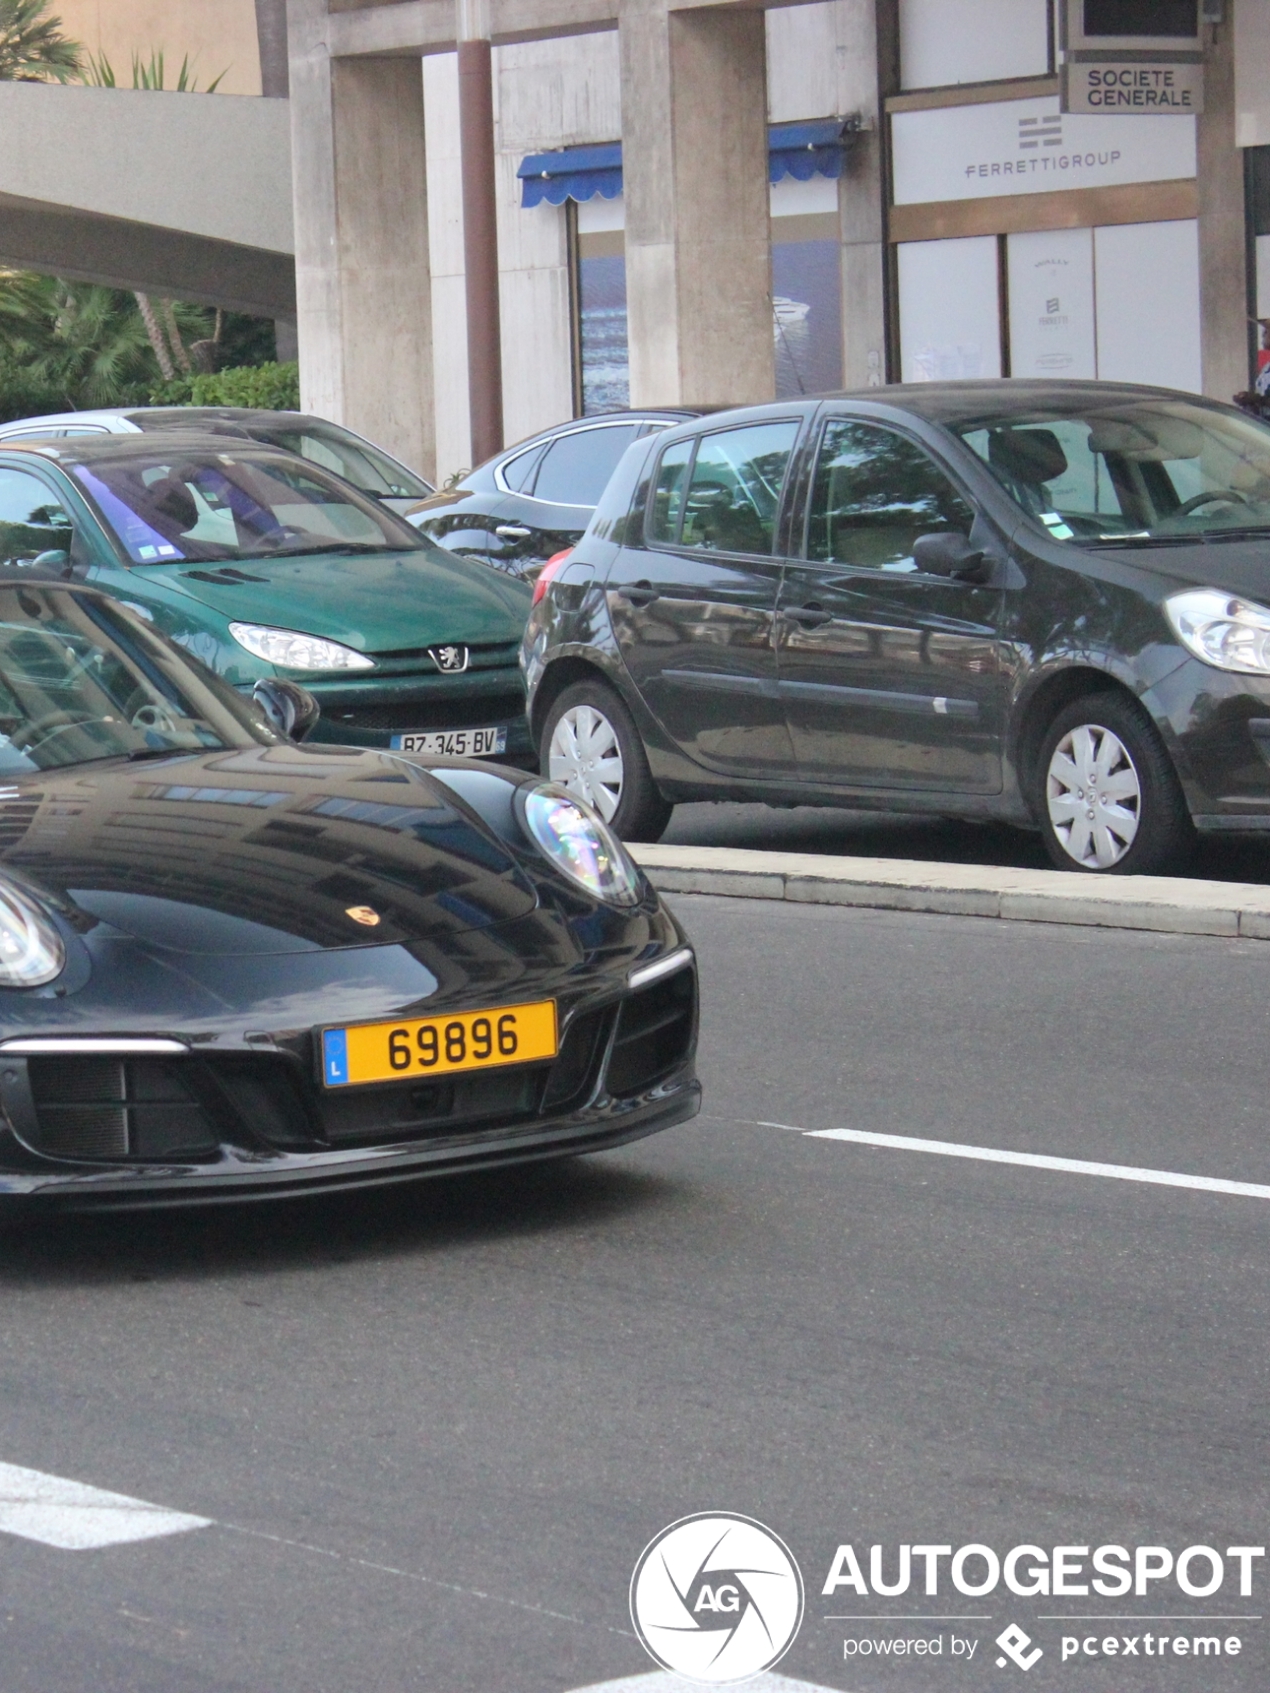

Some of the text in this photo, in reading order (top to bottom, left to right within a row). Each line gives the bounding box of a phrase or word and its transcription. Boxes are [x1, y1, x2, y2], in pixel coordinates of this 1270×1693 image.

[1088, 70, 1174, 86] SOCIETE
[1087, 89, 1192, 106] GENERALE
[964, 150, 1121, 178] FERRETTIGROUP
[330, 1014, 518, 1077] L 69896
